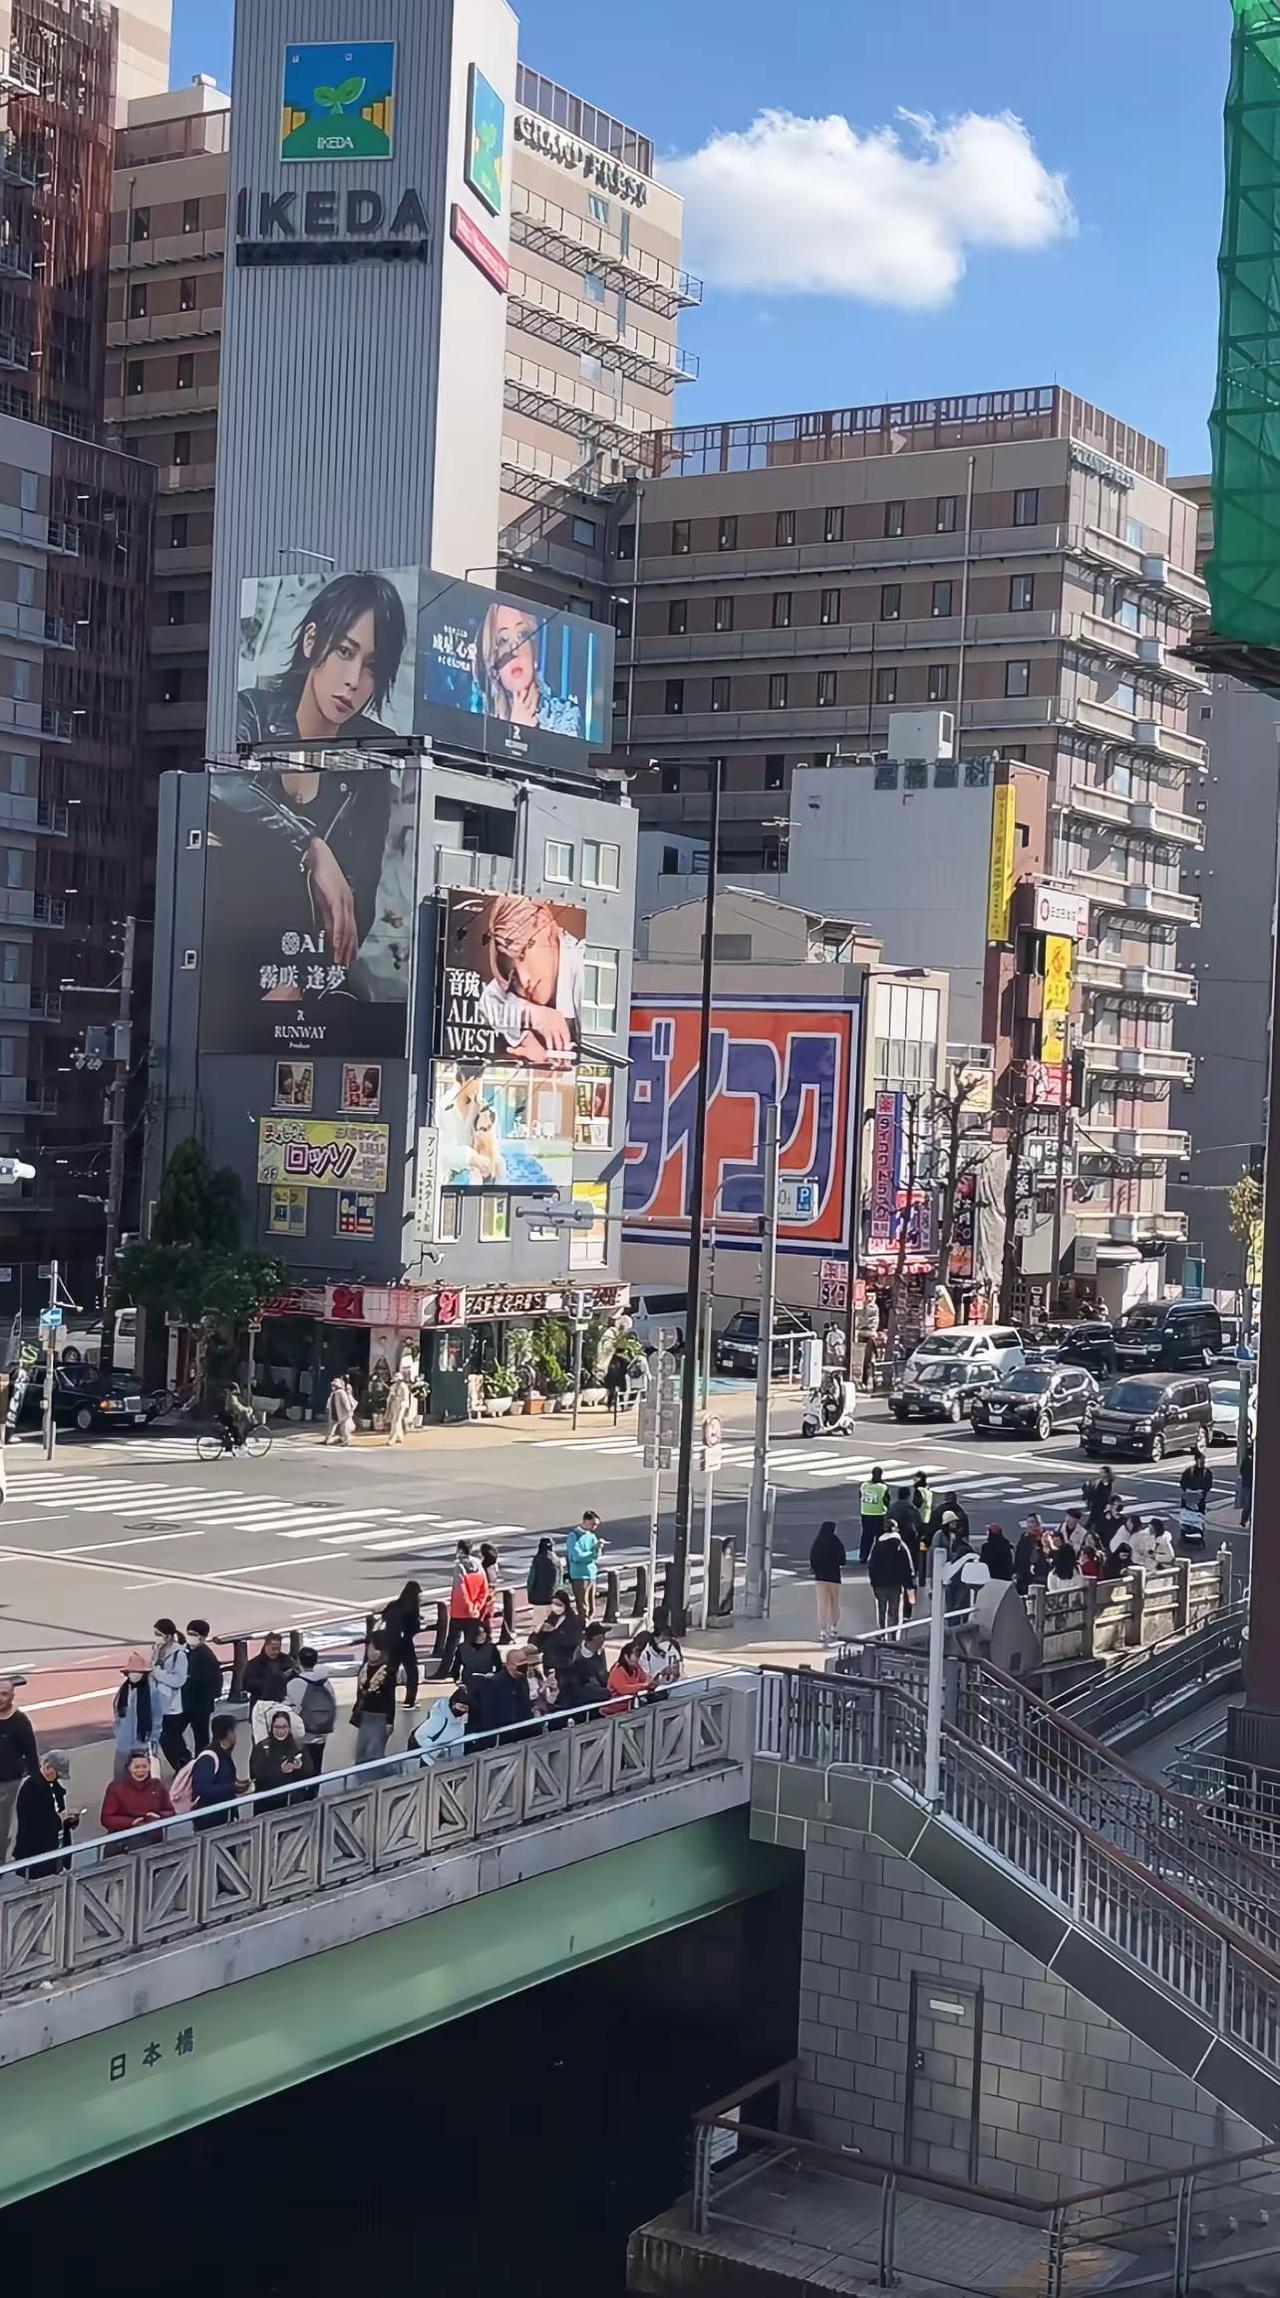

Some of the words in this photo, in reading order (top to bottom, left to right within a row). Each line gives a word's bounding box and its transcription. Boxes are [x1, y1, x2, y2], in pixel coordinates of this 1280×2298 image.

[236, 188, 428, 236] IKEDA
[274, 1025, 327, 1039] RUNWAY
[446, 1027, 498, 1054] WEST
[800, 1187, 809, 1203] P
[331, 1287, 364, 1320] 21
[109, 2026, 194, 2081] 日本橋
